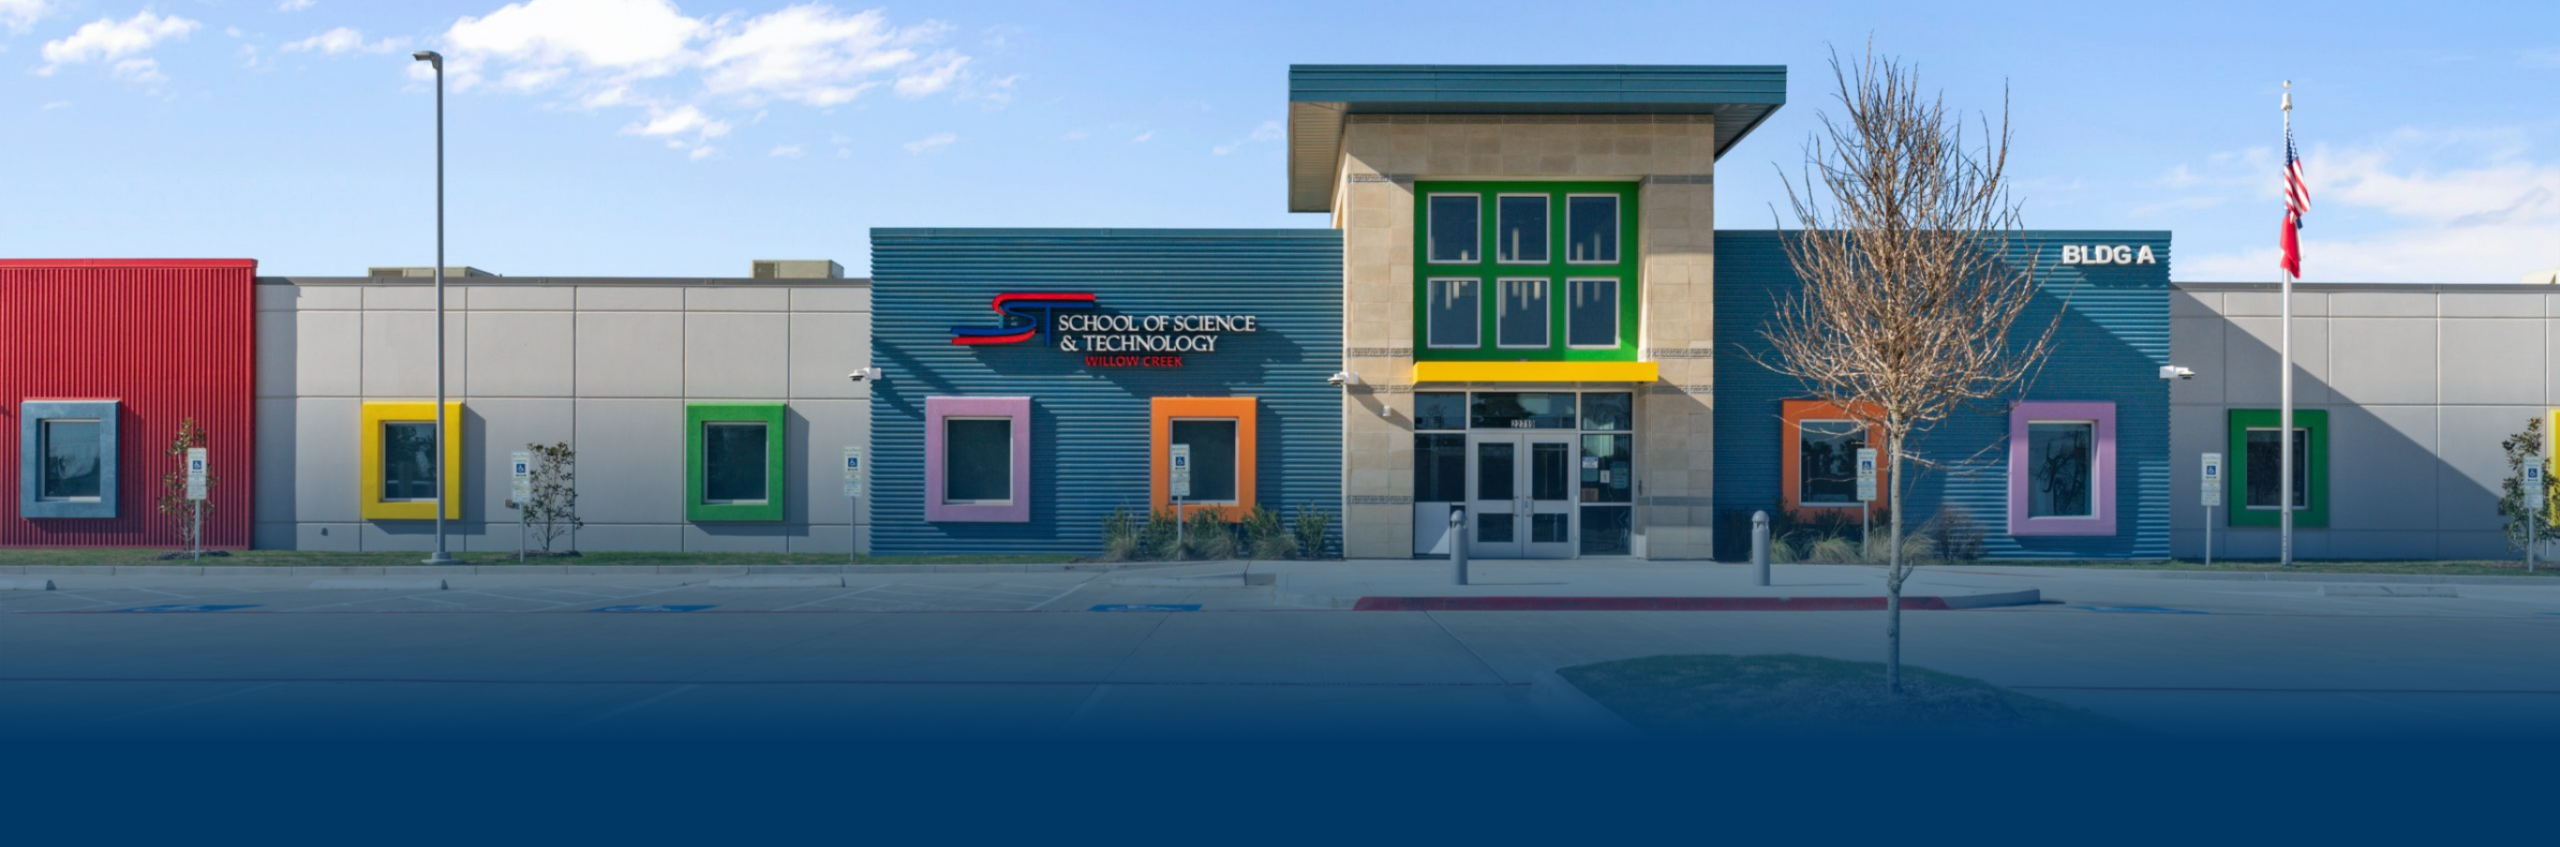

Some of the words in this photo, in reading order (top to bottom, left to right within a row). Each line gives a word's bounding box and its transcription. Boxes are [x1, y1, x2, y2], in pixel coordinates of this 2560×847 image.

[2062, 245, 2132, 265] BLDG
[2136, 245, 2156, 265] A
[1058, 314, 1140, 332] SCHOOL
[1143, 315, 1170, 332] OF
[1173, 315, 1256, 332] SCIENCE
[1060, 334, 1079, 352] &
[1082, 334, 1218, 352] TECHNOLOGY
[1085, 355, 1139, 368] WILLOW
[1142, 355, 1183, 368] CREEK
